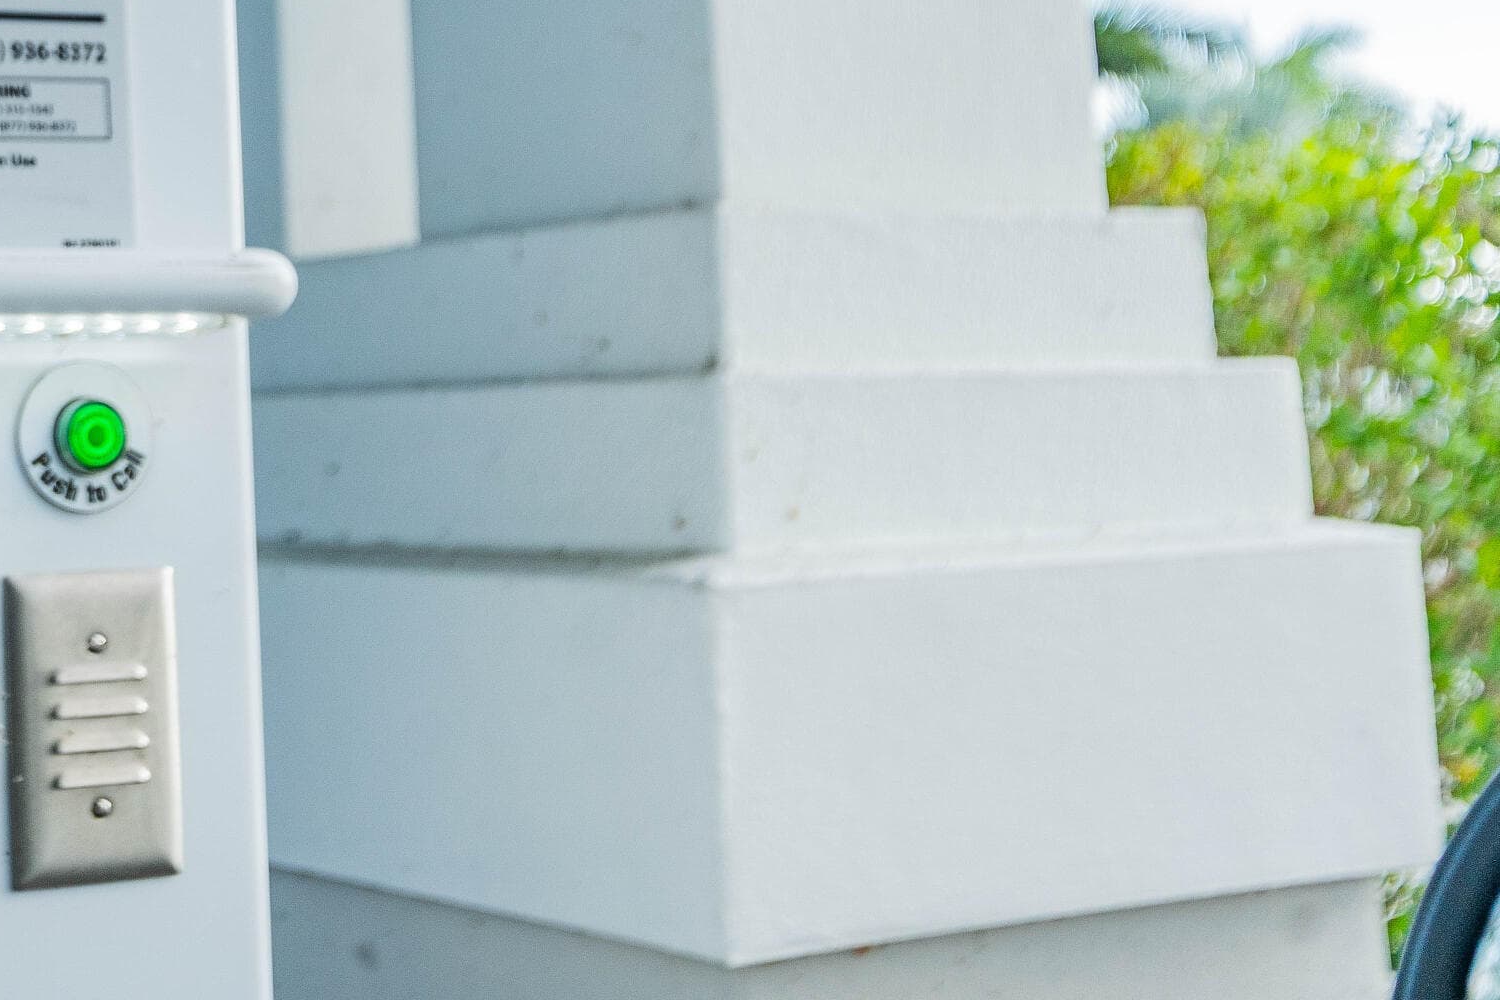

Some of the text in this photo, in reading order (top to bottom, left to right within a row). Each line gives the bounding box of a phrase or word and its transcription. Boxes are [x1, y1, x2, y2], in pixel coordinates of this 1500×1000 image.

[11, 154, 38, 167] Use
[31, 449, 146, 503] Push to Call
